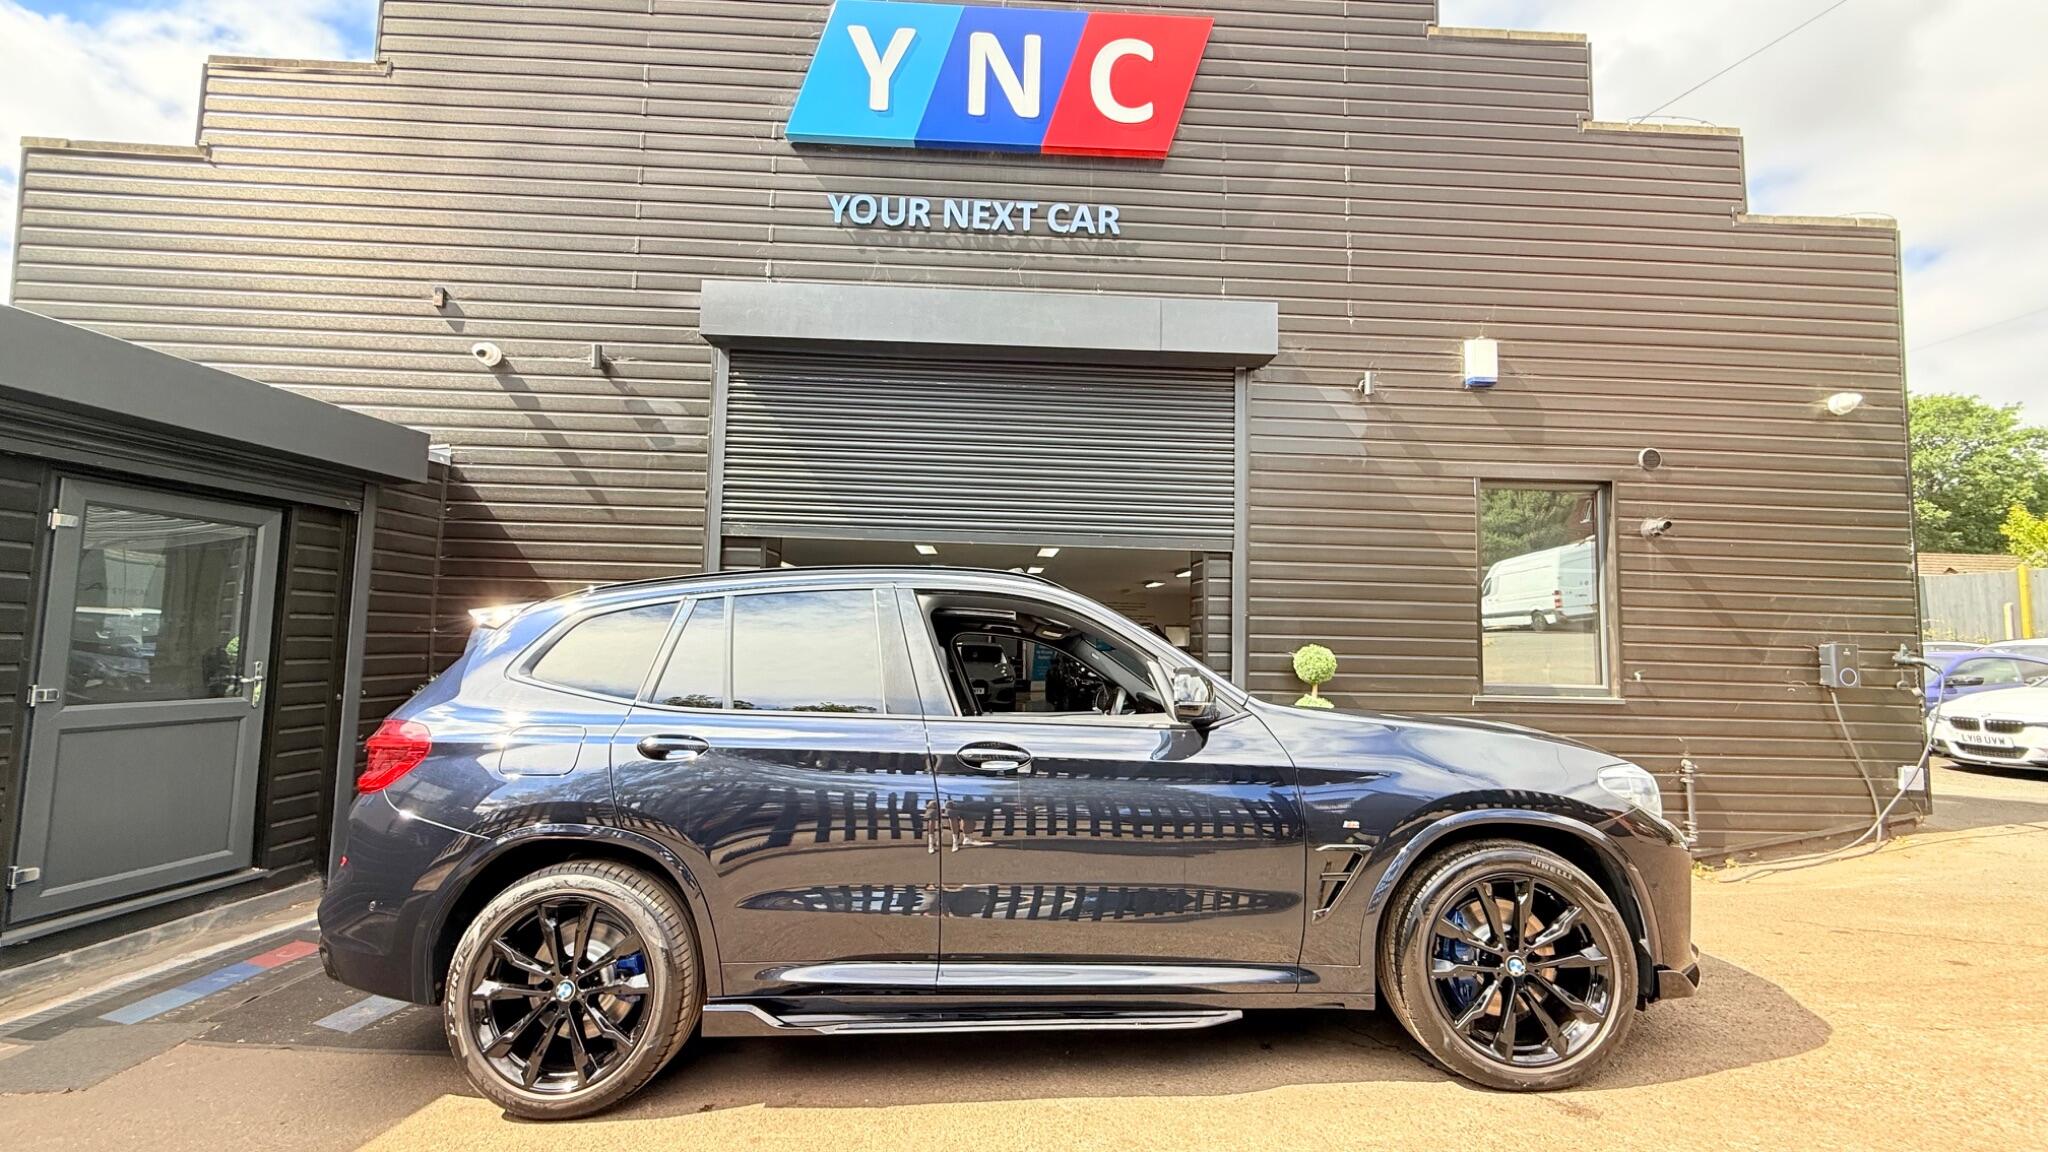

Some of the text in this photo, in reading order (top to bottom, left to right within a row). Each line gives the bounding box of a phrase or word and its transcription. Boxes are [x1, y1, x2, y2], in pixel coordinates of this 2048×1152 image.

[847, 25, 1153, 124] YNC
[827, 192, 1120, 235] YOUR NEXT CAR
[1530, 855, 1573, 881] PIRELLI
[447, 955, 466, 1018] ZERO
